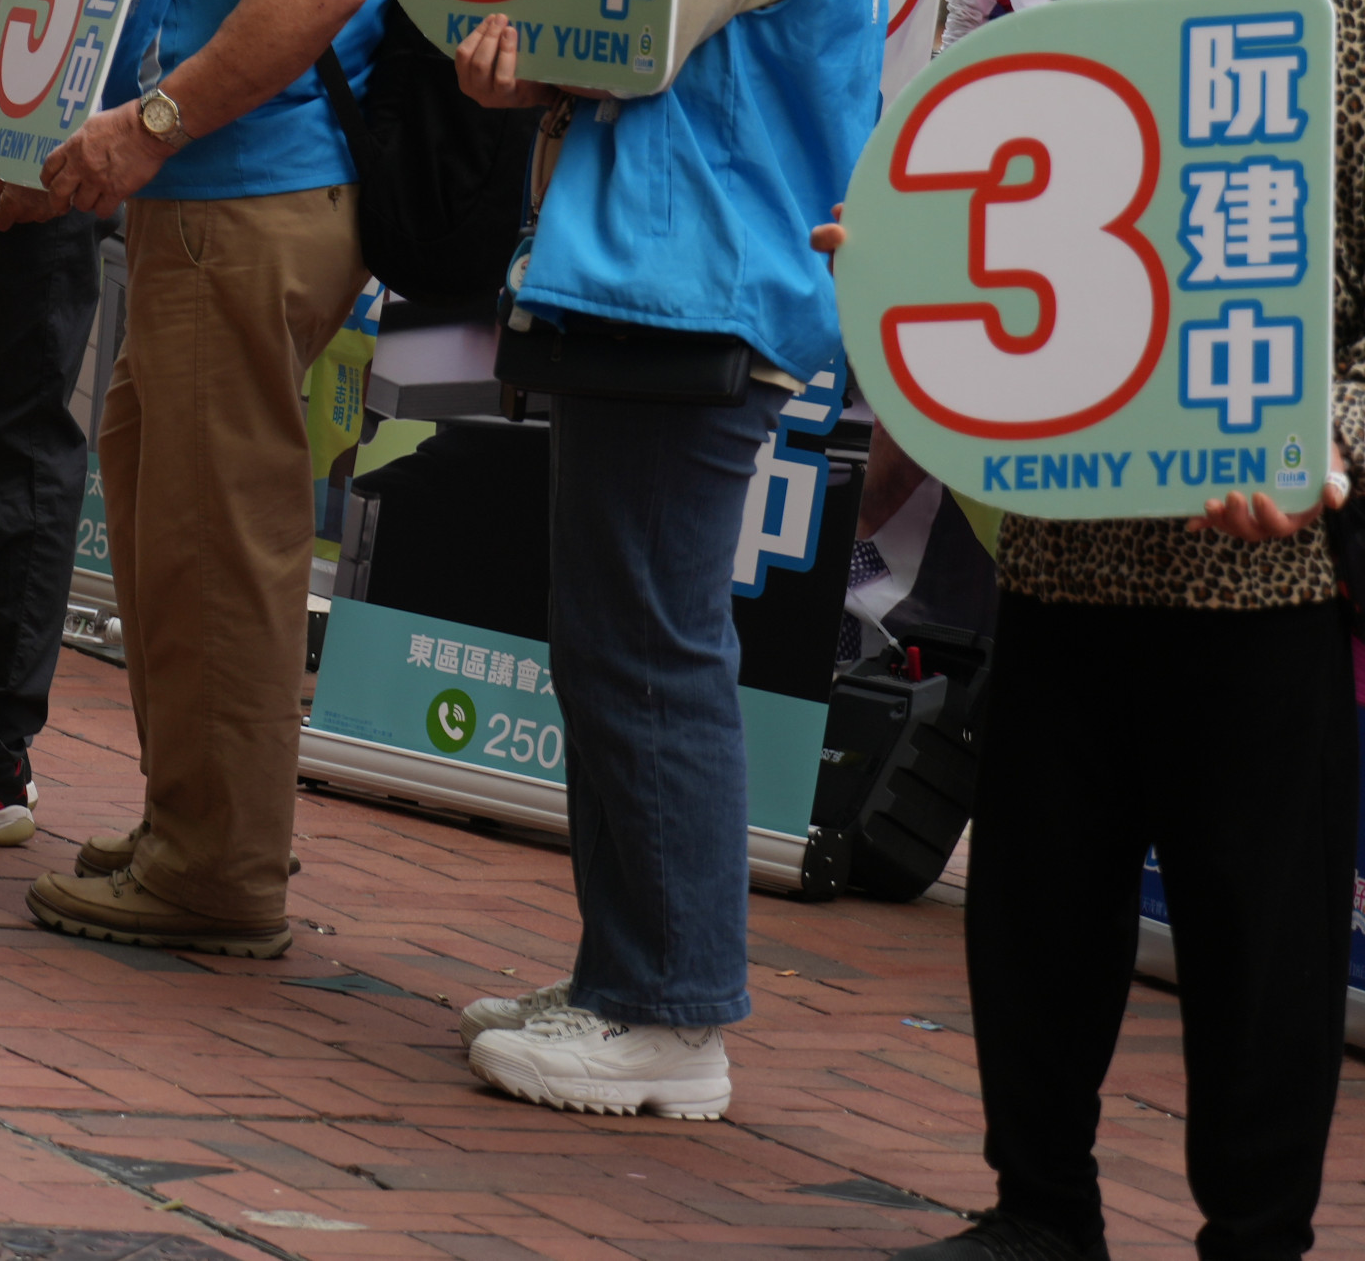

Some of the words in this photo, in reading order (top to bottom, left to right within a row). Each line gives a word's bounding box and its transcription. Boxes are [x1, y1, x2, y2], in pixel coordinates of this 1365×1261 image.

[553, 26, 630, 66] YUEN
[879, 51, 1171, 442] 3
[1175, 10, 1309, 434] 阮建中
[982, 451, 1133, 492] KENNY
[1147, 447, 1267, 487] YUEN
